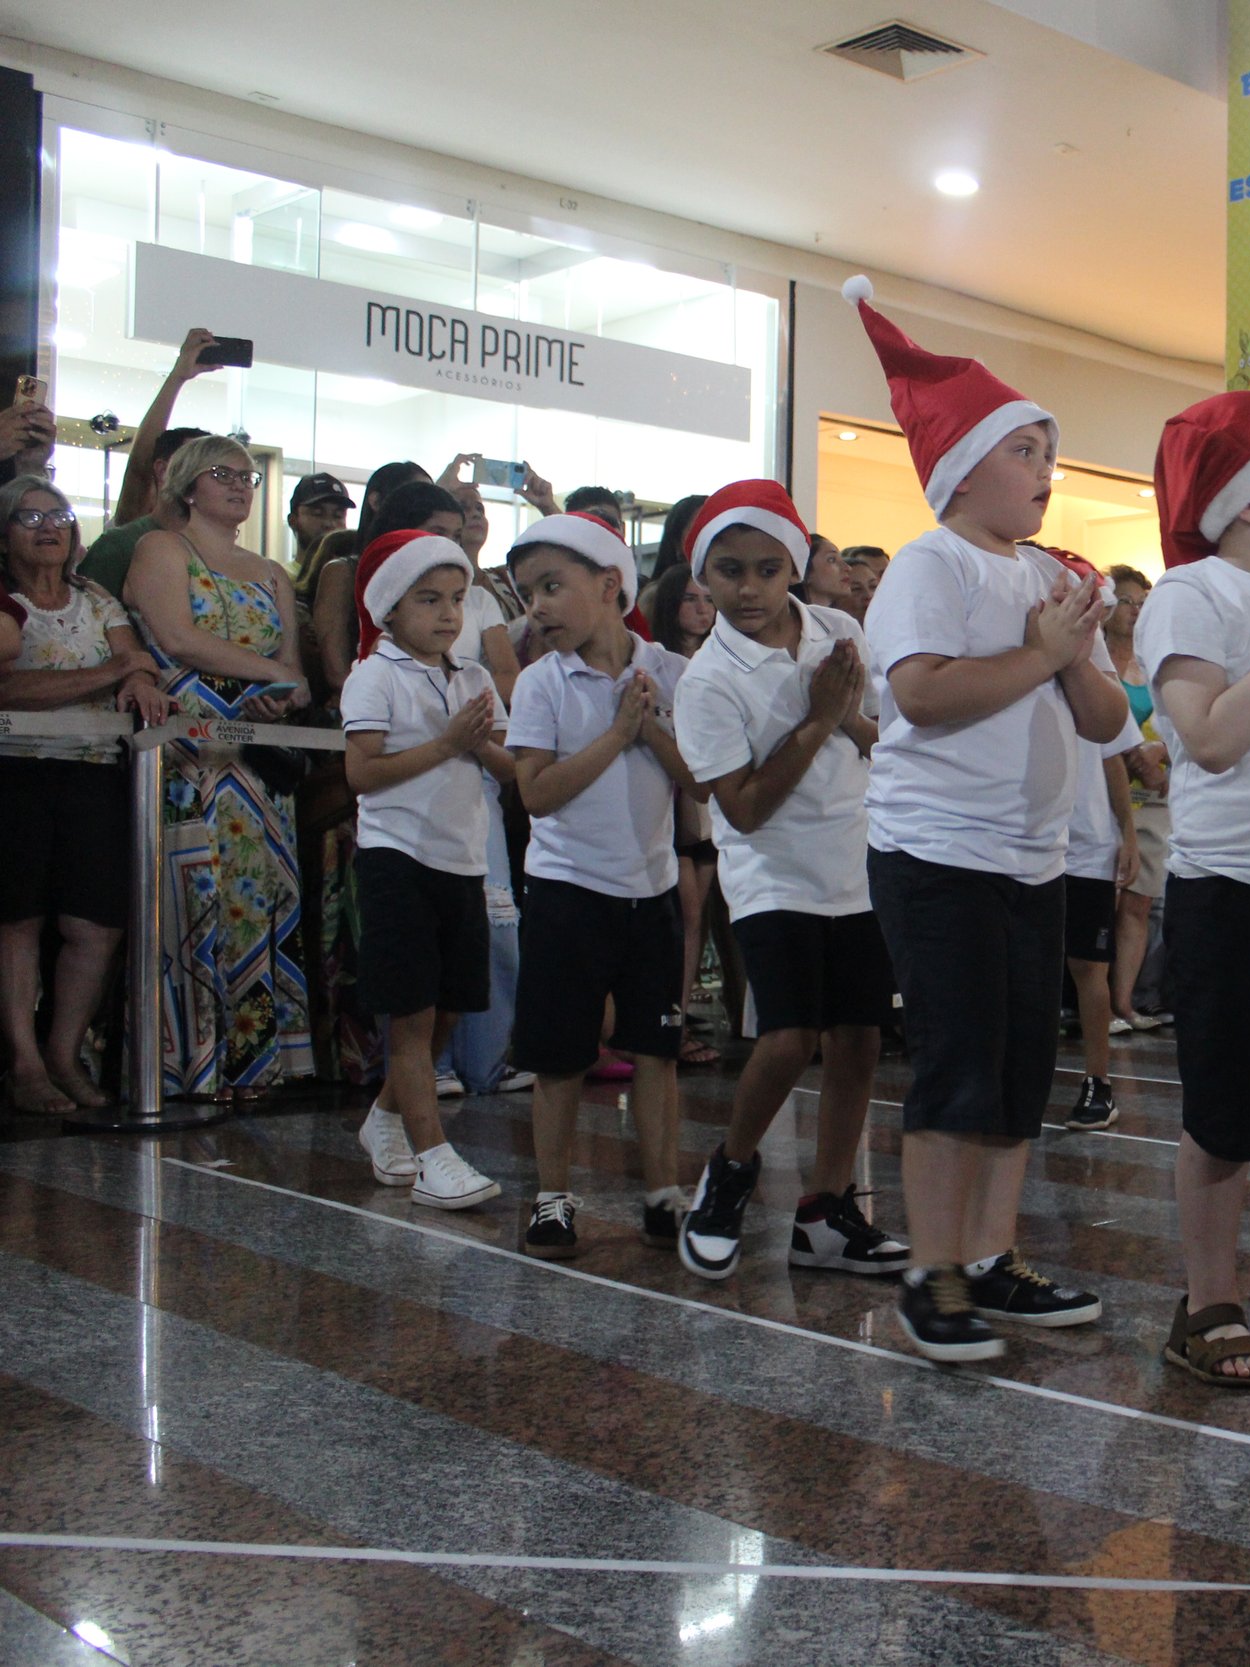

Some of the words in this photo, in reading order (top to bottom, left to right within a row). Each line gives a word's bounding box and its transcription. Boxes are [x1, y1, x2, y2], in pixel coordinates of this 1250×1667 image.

[366, 301, 468, 365] MOÇA
[480, 325, 585, 386] PRIME
[436, 368, 523, 391] ACESSÓRIOS
[216, 725, 256, 735] AVENIDA
[218, 733, 254, 743] CENTER
